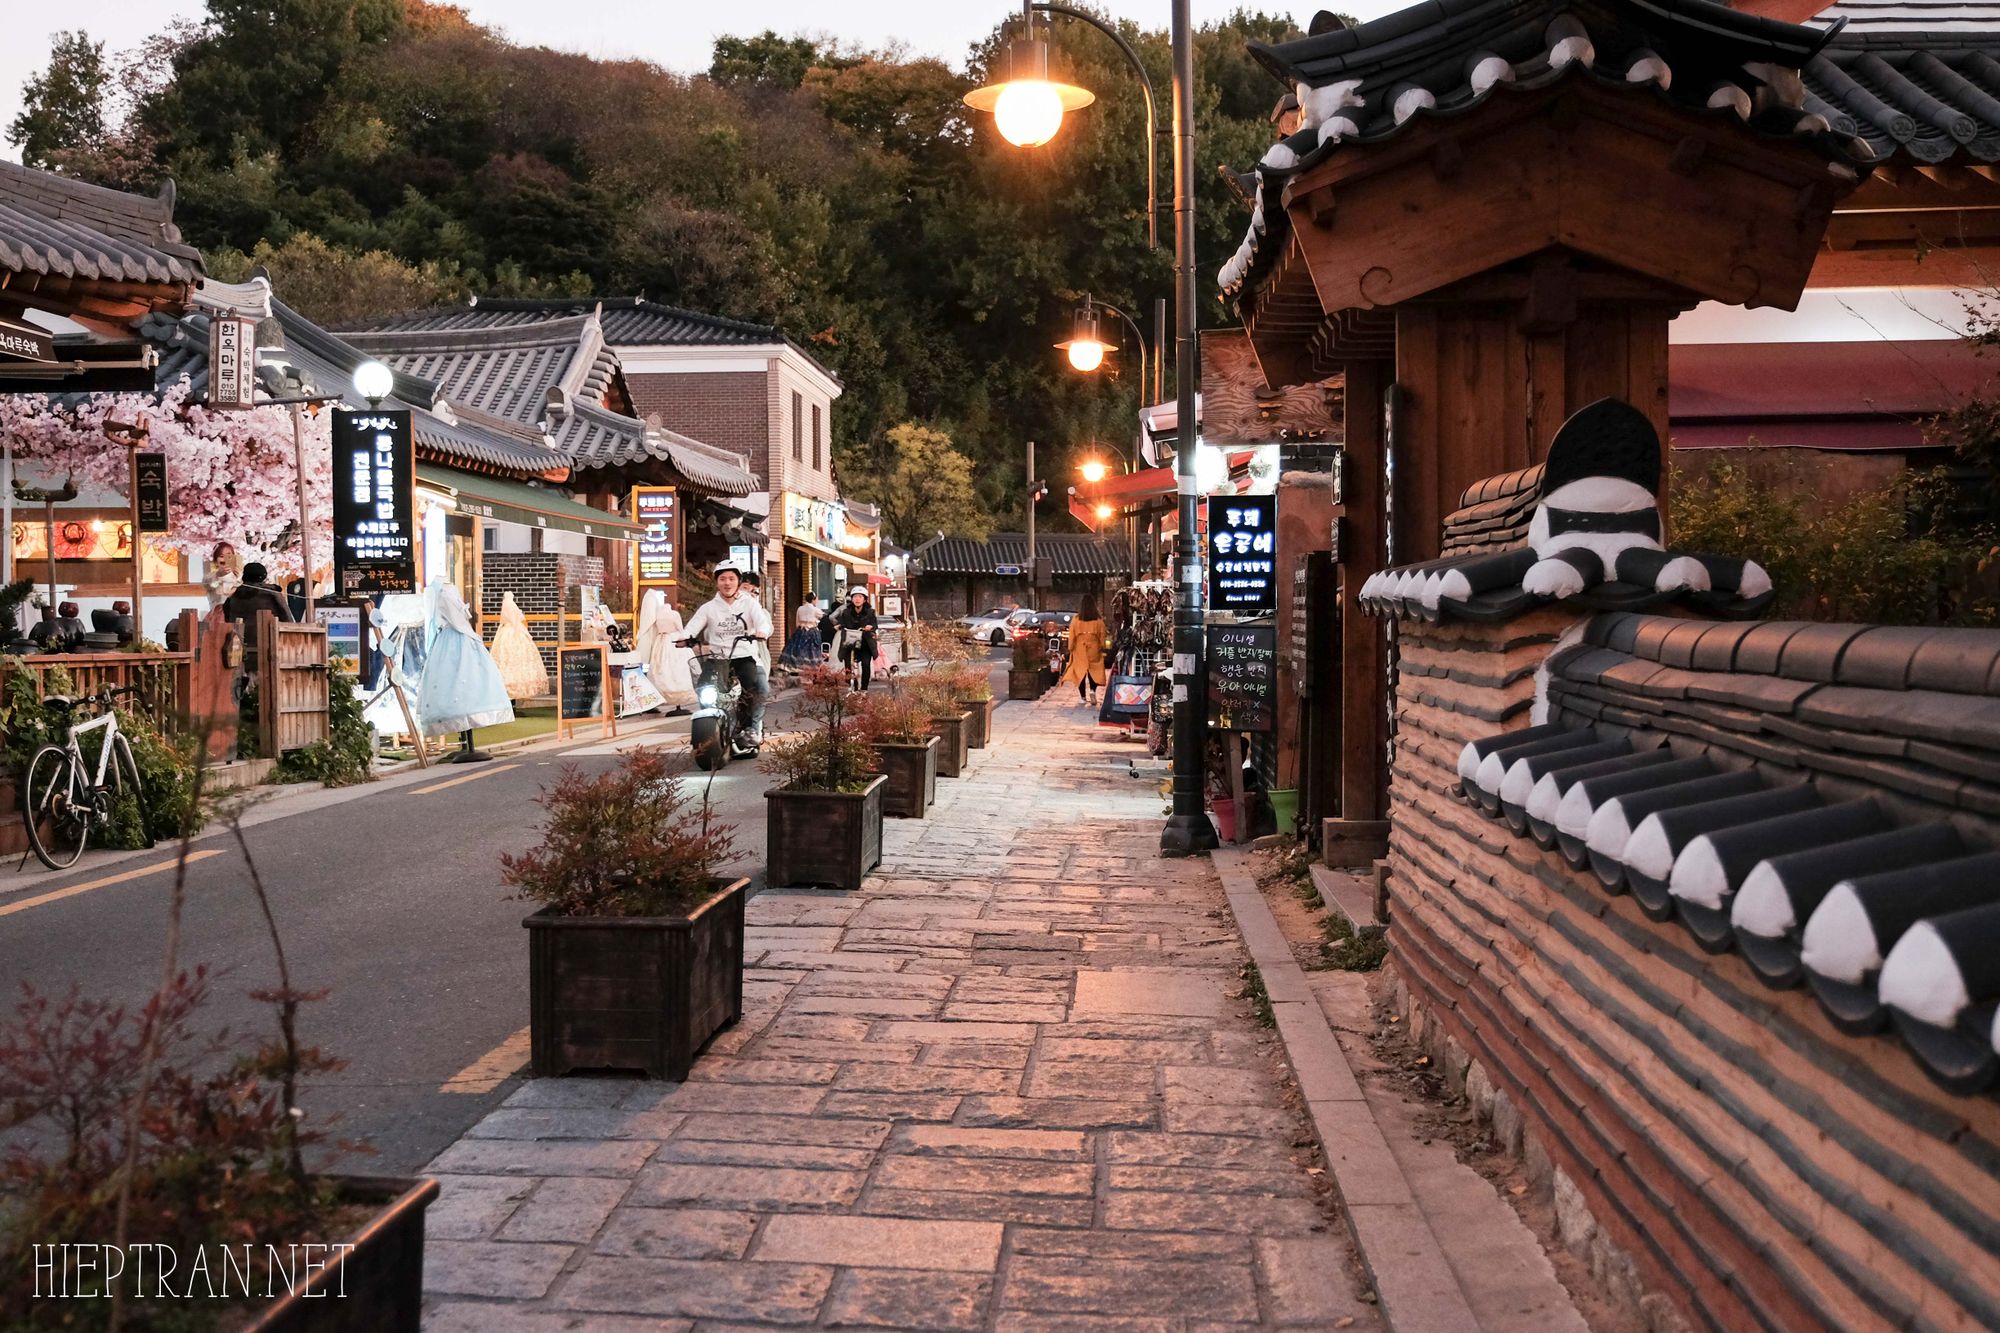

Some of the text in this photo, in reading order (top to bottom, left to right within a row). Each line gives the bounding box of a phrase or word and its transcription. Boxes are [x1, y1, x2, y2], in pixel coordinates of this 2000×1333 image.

[221, 323, 236, 381] 한옥마루
[140, 470, 163, 518] 숙박
[1213, 531, 1273, 554] 은공예
[367, 570, 396, 579] 꿈꾸는
[1221, 664, 1267, 678] 행운 반지
[1216, 679, 1240, 693] 유아
